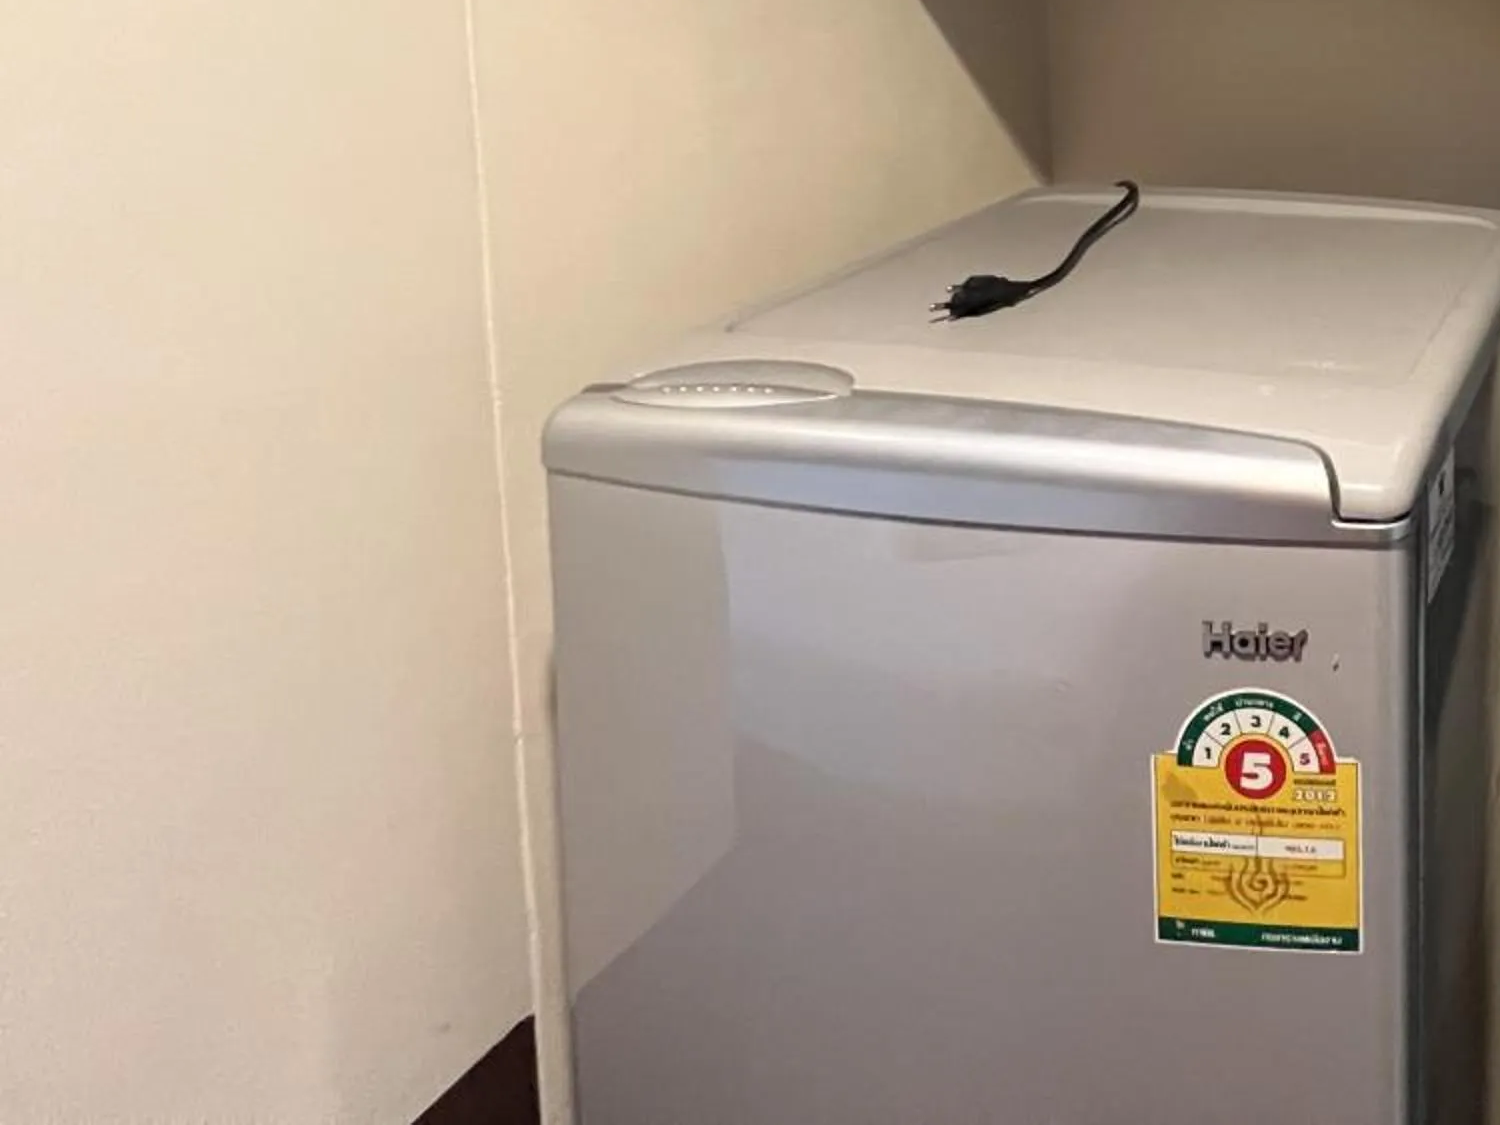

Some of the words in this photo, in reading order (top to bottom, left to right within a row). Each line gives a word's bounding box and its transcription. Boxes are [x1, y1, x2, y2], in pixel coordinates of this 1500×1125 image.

[1202, 620, 1309, 663] Haier
[1205, 747, 1212, 759] 1
[1221, 723, 1231, 736] 2
[1251, 715, 1262, 728] 3
[1279, 726, 1290, 739] 4
[1300, 753, 1310, 765] 5
[1239, 751, 1274, 791] 5
